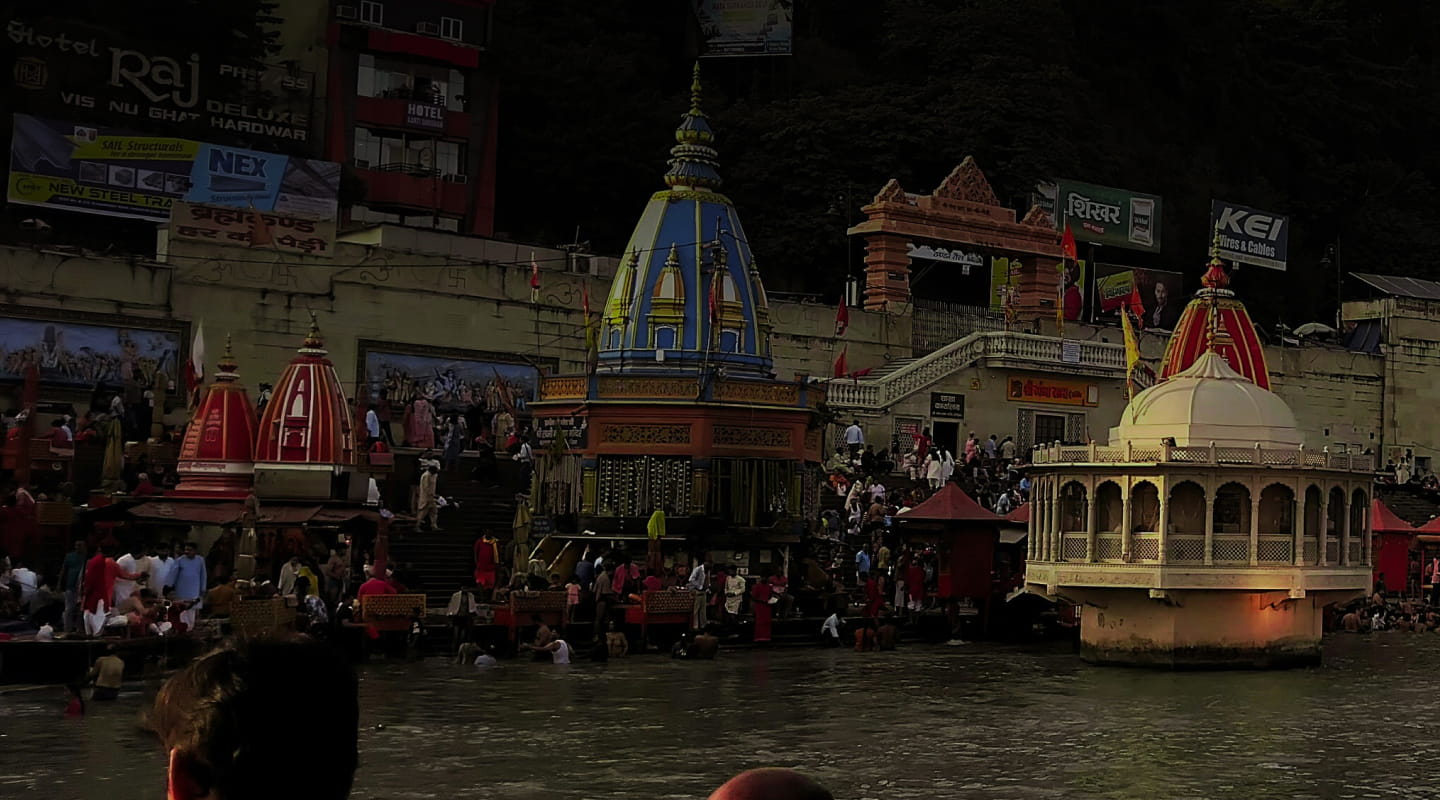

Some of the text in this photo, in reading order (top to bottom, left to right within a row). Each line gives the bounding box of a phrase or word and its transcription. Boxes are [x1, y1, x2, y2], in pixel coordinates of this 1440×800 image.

[7, 20, 99, 56] Hotel
[107, 47, 200, 108] Raj
[60, 90, 307, 140] VIS NU GHAT HARDWAR
[206, 99, 308, 127] DELUXE
[407, 103, 443, 119] HOTEL
[102, 139, 184, 152] SAIL Structurals
[208, 148, 269, 179] NEX
[49, 183, 85, 196] NEW
[89, 188, 138, 203] STEEL
[1067, 192, 1121, 224] शिखर
[1218, 207, 1284, 241] KEI
[1240, 240, 1247, 252] &
[1248, 240, 1275, 258] Cables
